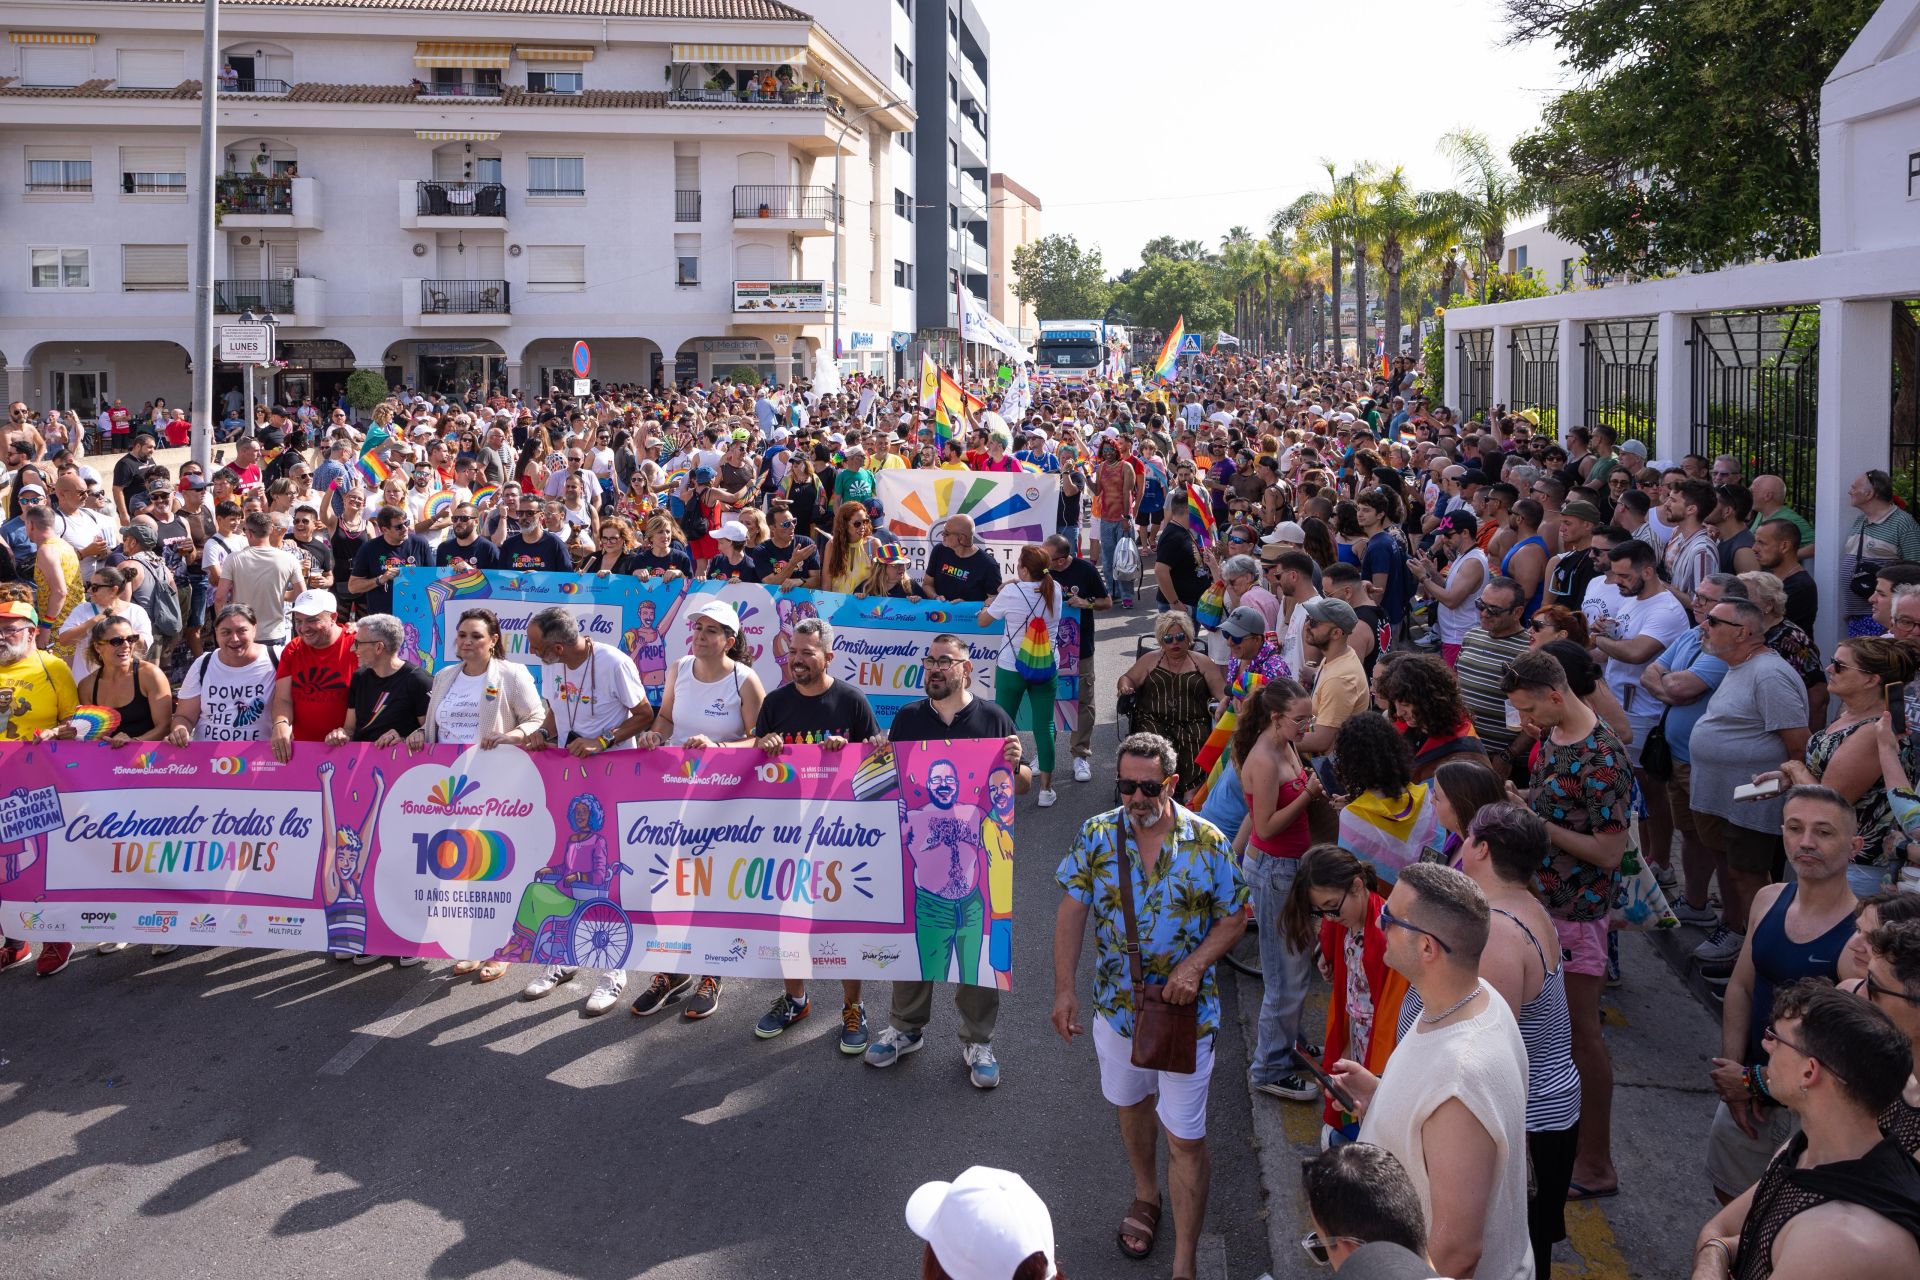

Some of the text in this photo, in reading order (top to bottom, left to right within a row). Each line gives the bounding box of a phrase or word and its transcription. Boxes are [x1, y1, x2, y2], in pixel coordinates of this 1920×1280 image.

[230, 342, 258, 351] LUNES
[717, 341, 759, 349] Medident
[941, 563, 970, 579] PRIDE
[590, 614, 614, 634] las
[895, 612, 917, 622] Pride
[639, 644, 664, 660] PRIDE
[832, 634, 920, 662] Construyendo
[859, 662, 884, 687] EN
[208, 684, 265, 700] POWER
[207, 702, 227, 715] TO
[207, 713, 232, 725] THE
[204, 725, 260, 741] PEOPLE
[168, 763, 197, 775] Pride
[710, 773, 741, 786] Pride
[0, 789, 53, 812] LAS VIDAS
[485, 797, 534, 818] Pride
[65, 805, 312, 842] Celebrando todas las
[626, 815, 886, 856] Construyendo un futuro
[111, 840, 279, 873] IDENTIDADES
[675, 856, 843, 905] EN COLORES
[414, 888, 512, 904] 10 AÑOS CELEBRANDO
[428, 906, 496, 920] LA DIVERSIDAD
[138, 913, 177, 933] colega
[268, 927, 302, 936] MULTIPLEX
[704, 953, 738, 963] Diversport
